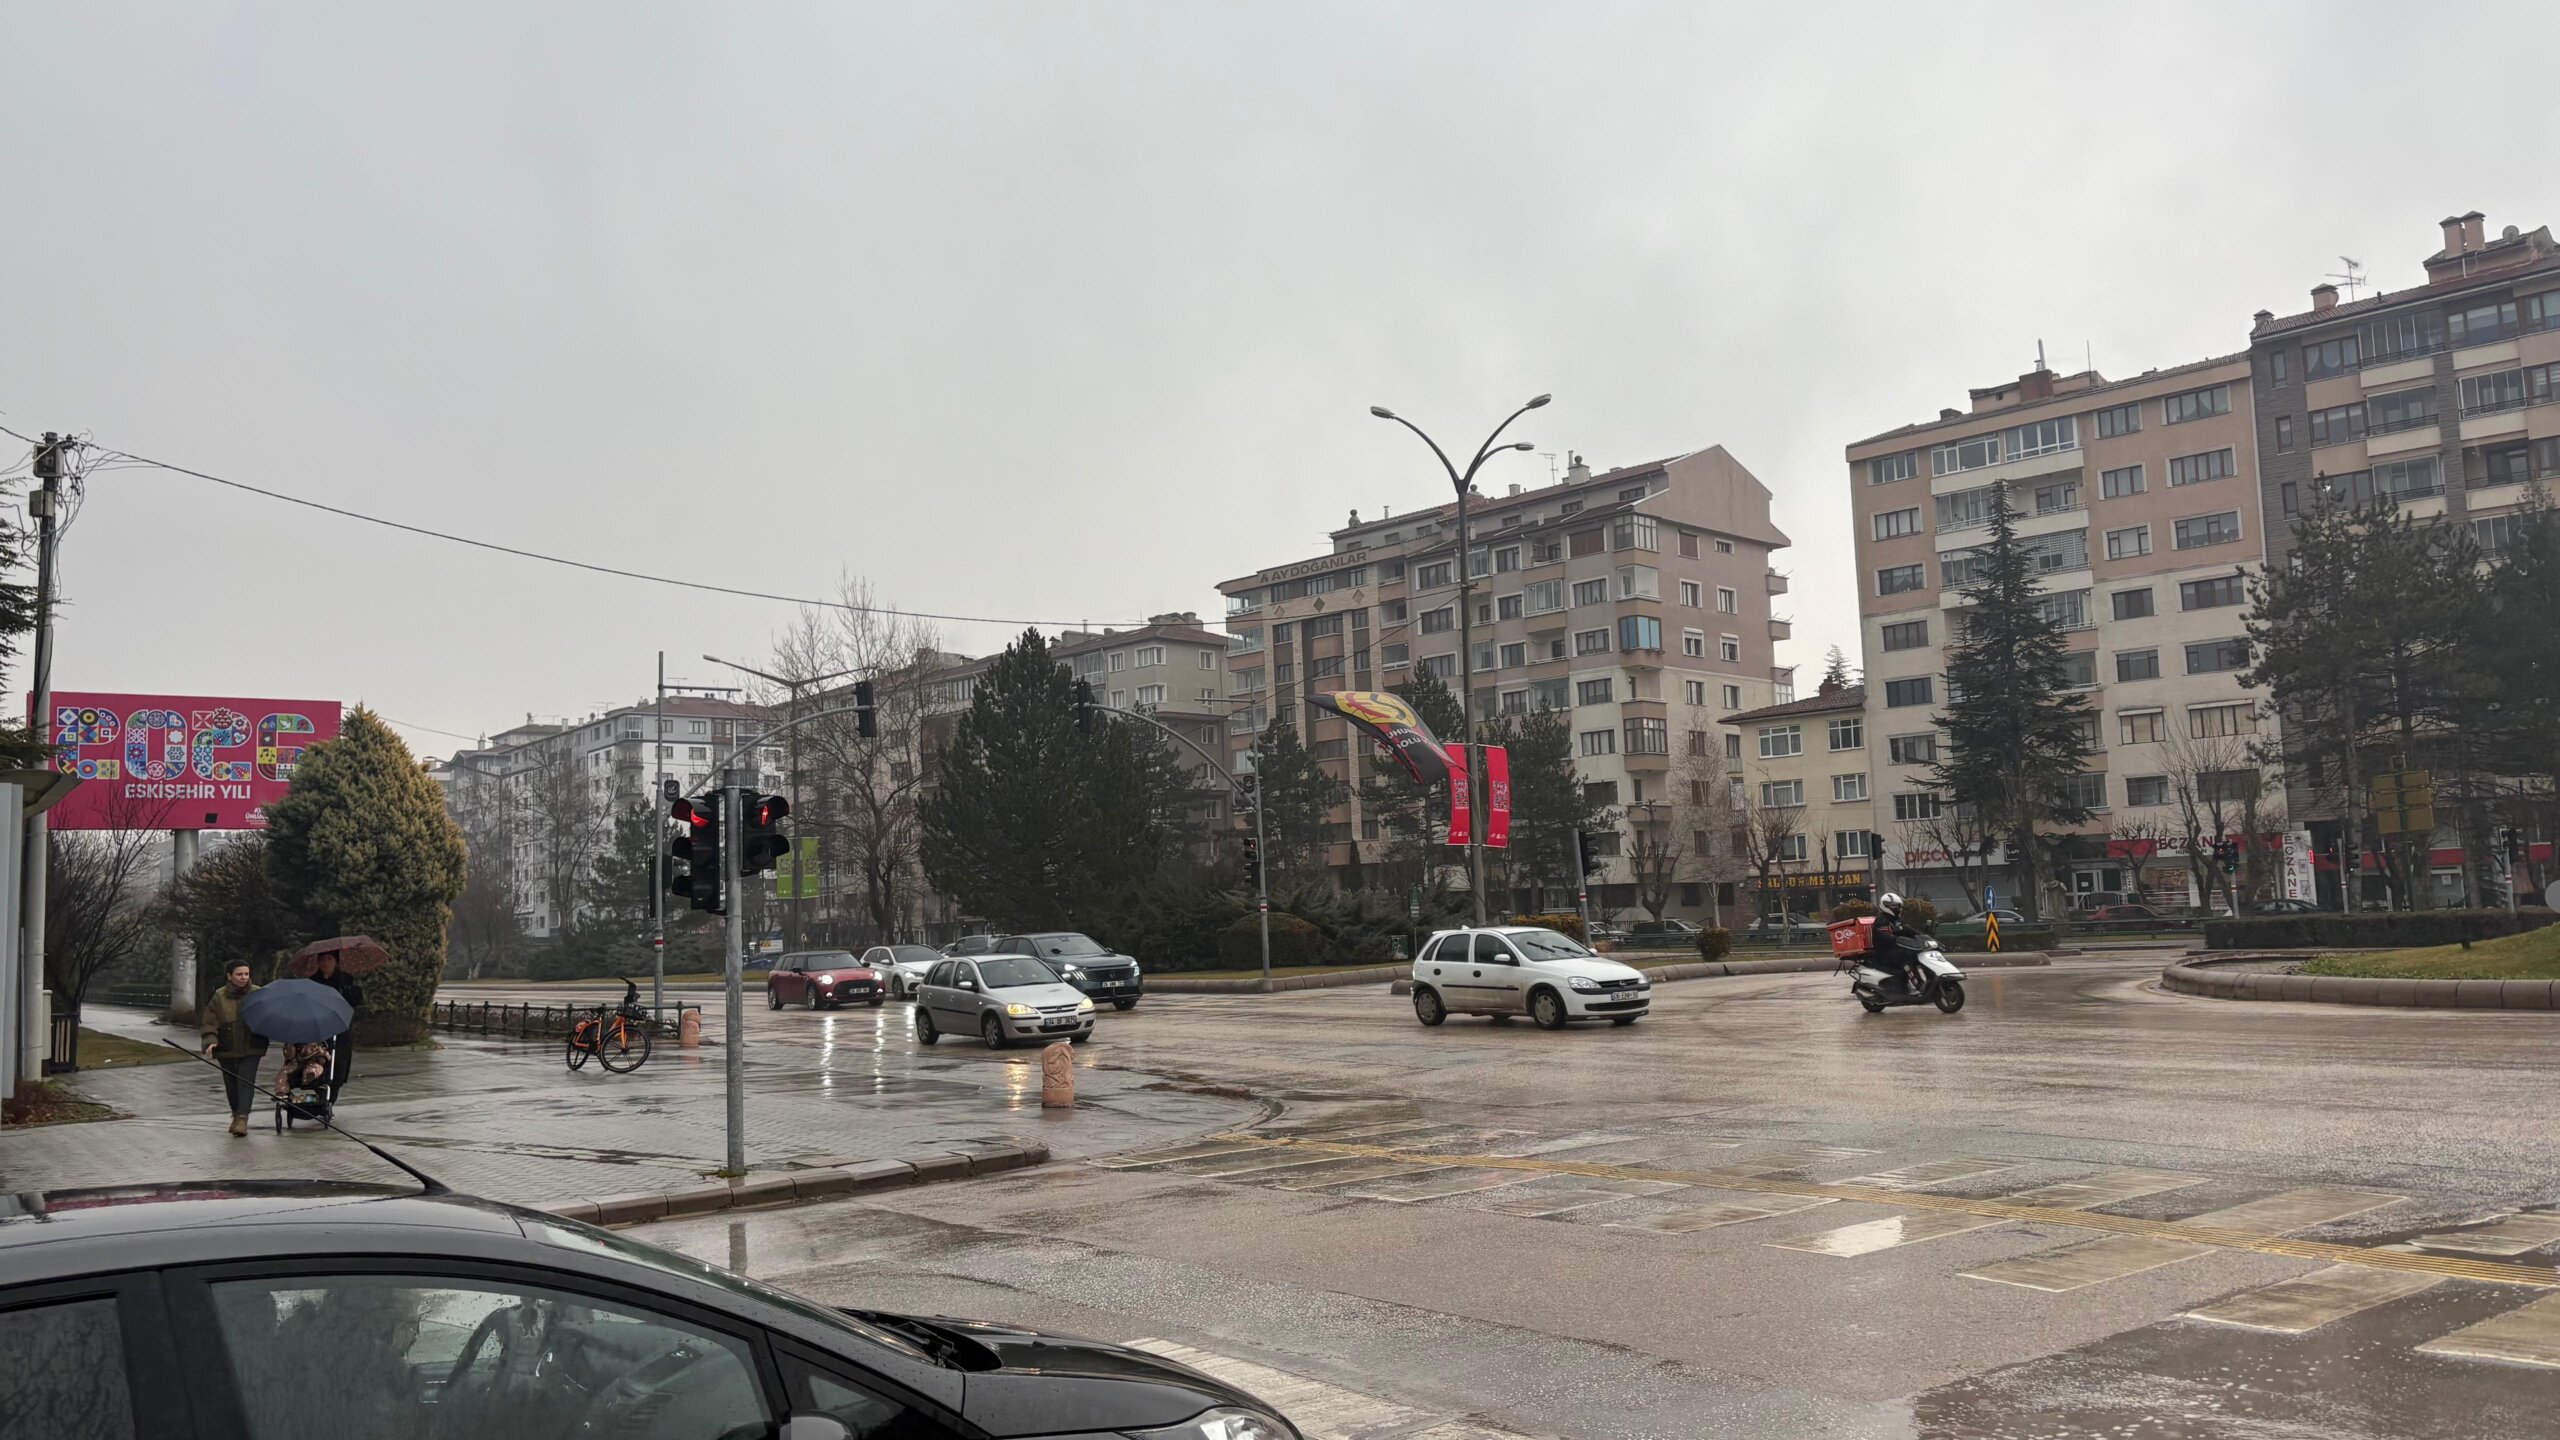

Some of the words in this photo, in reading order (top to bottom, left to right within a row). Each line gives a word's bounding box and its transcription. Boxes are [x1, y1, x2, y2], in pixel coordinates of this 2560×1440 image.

[1271, 551, 1367, 581] AYDOĞANLAR
[56, 706, 315, 782] 2026
[125, 781, 216, 801] ESKİŞEHİR
[220, 784, 251, 800] YILI
[1809, 873, 1861, 887] MERCAN
[2284, 835, 2298, 898] ECZANE
